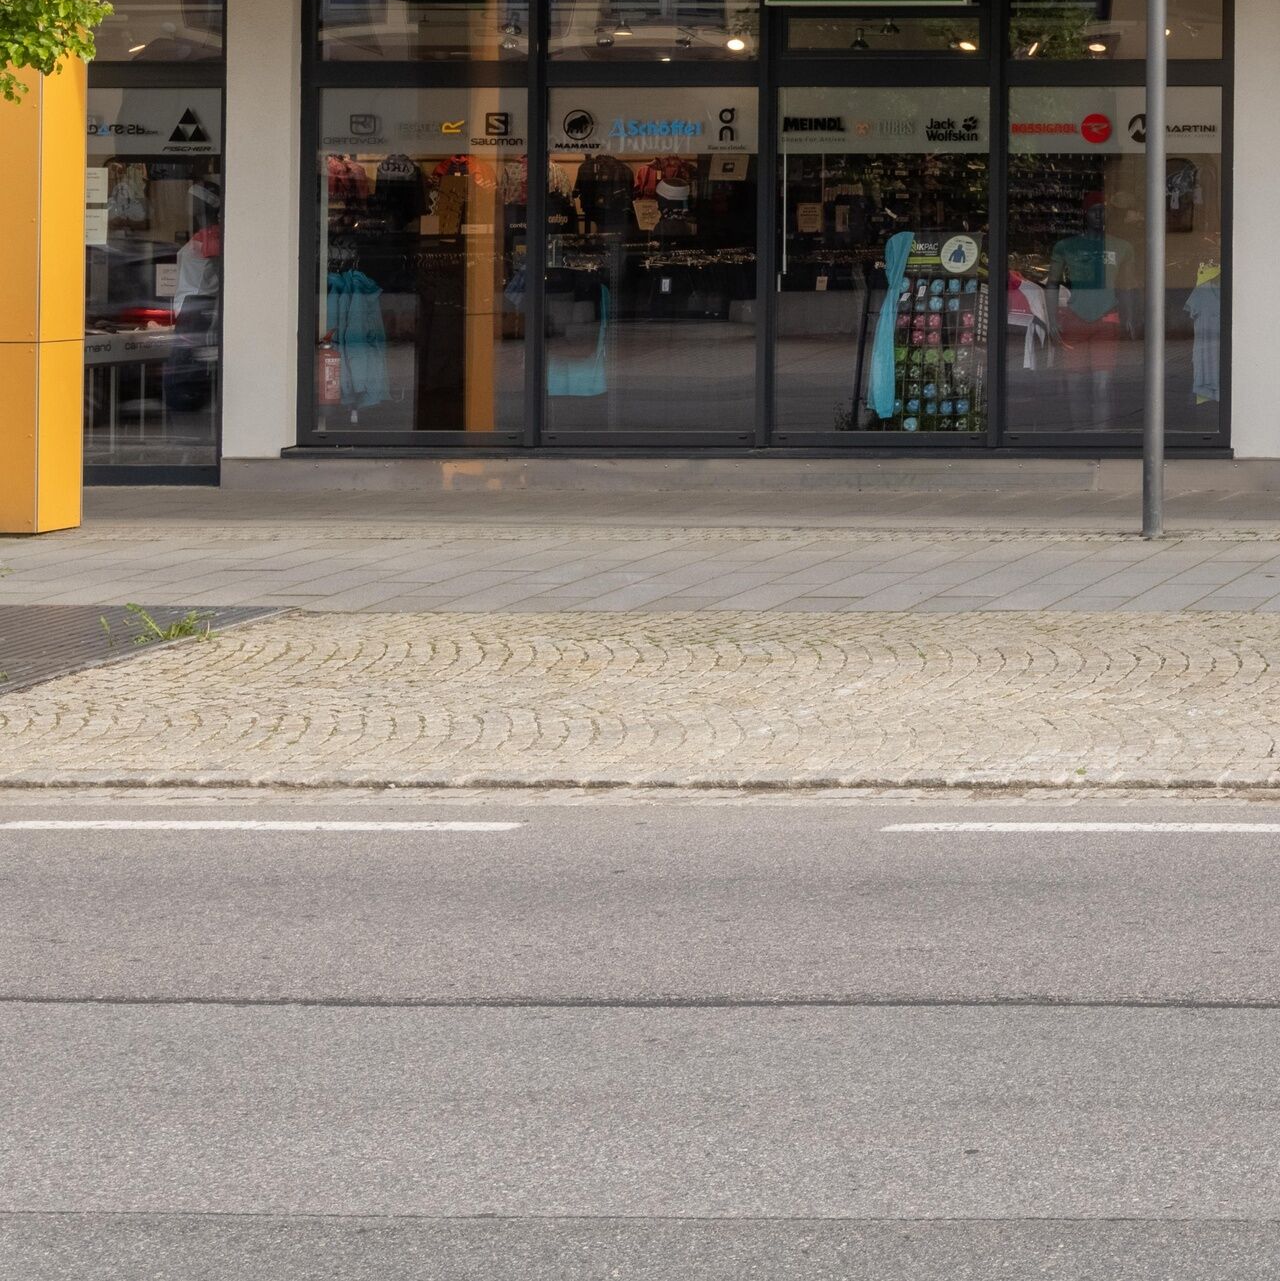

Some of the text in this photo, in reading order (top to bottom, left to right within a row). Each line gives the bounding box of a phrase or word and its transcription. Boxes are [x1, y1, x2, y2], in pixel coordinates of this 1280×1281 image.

[783, 116, 846, 133] MEINDL
[927, 118, 955, 131] Jack
[322, 136, 386, 145] ORTOVOX
[926, 130, 979, 142] Wolfskin
